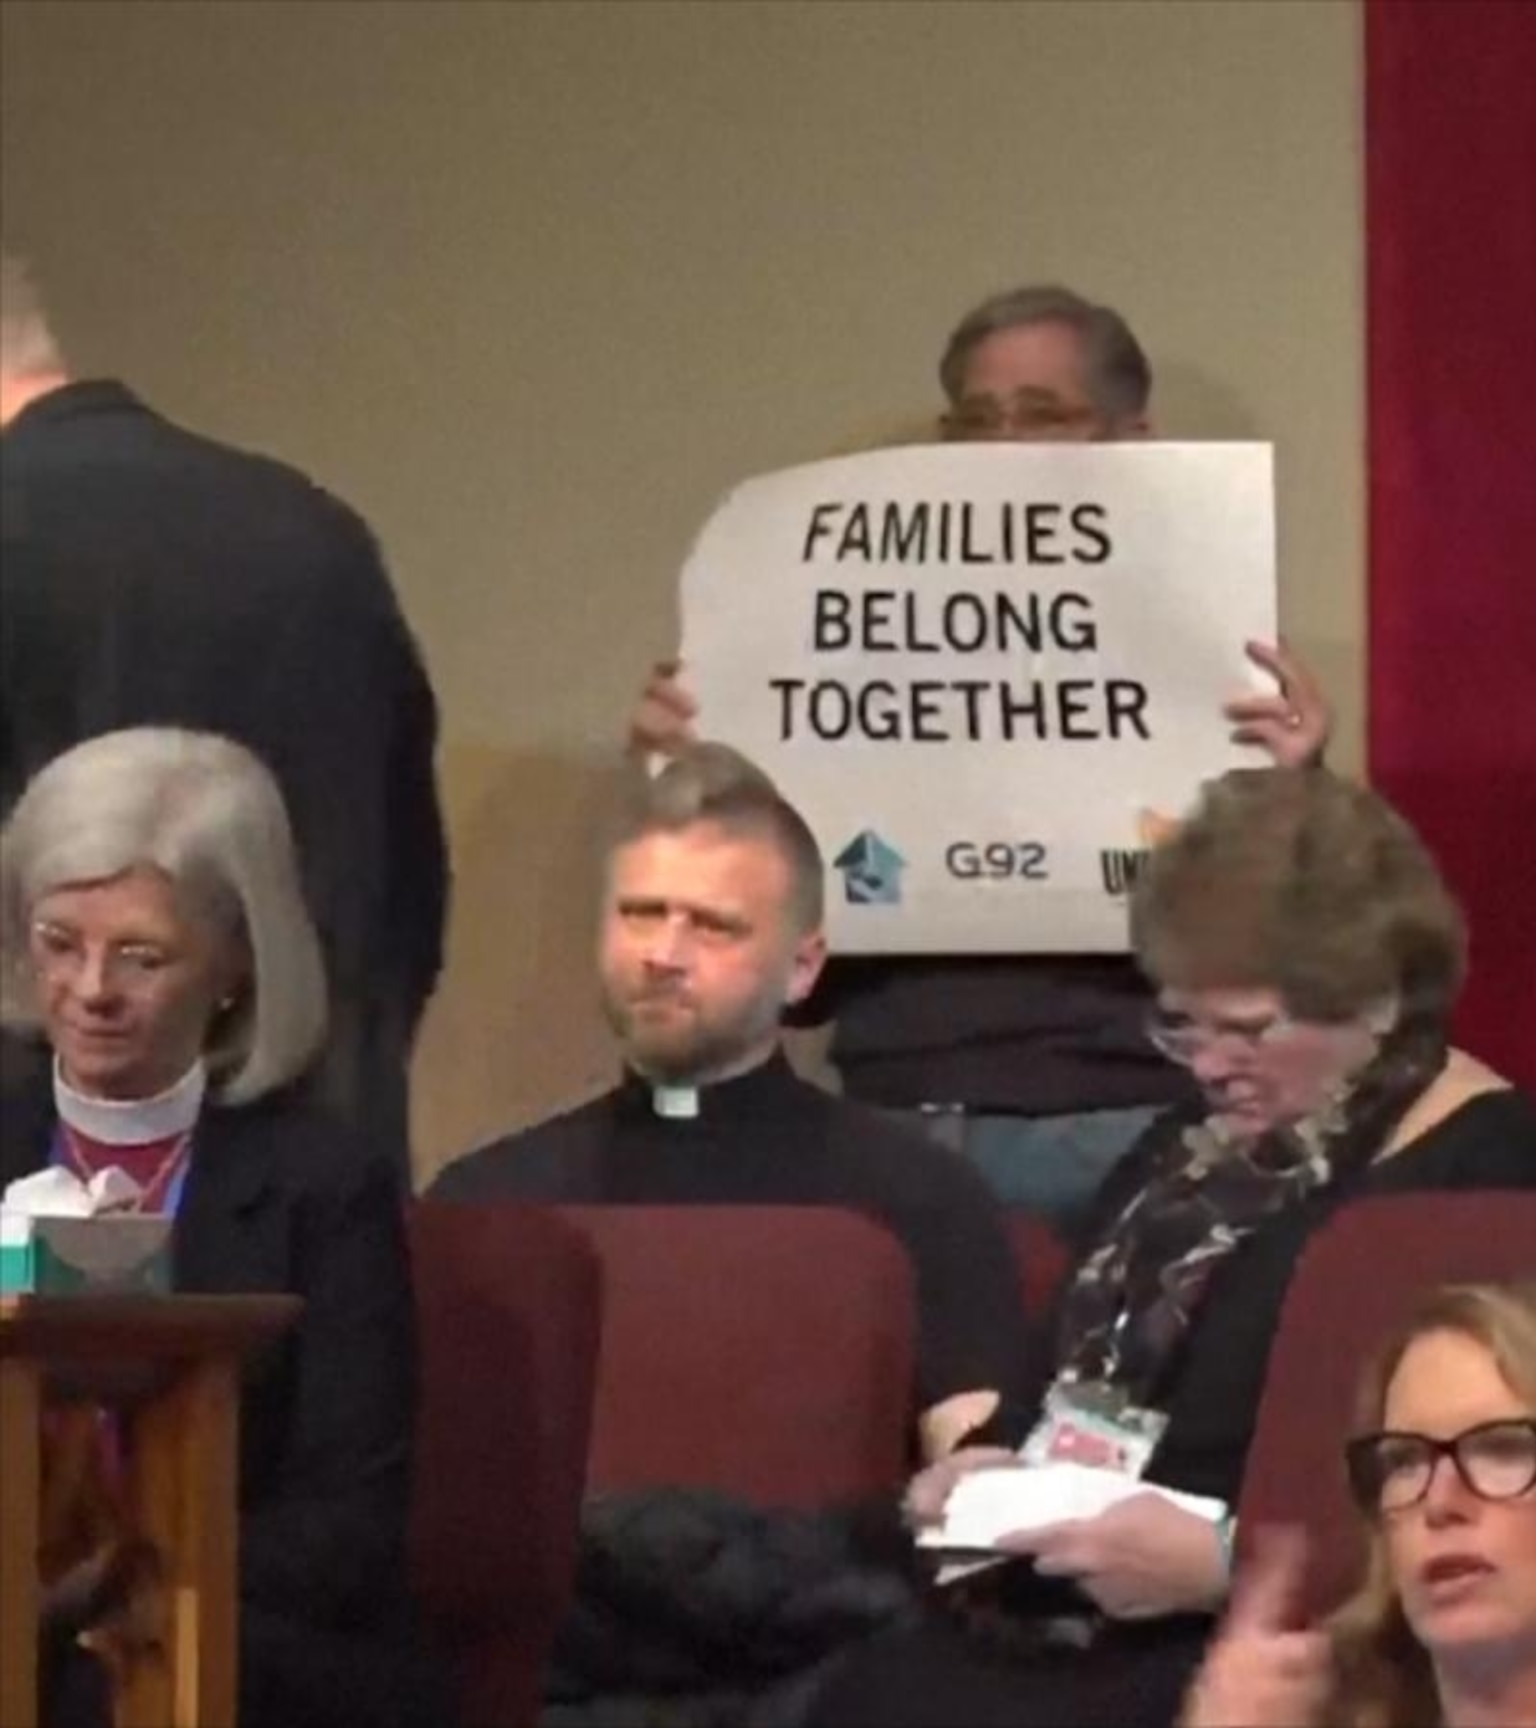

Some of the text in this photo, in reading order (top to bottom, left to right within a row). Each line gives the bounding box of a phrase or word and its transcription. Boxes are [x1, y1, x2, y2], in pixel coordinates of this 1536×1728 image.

[802, 500, 1114, 566] FAMILIES
[813, 588, 1099, 654] BELONG
[768, 678, 1152, 743] TOGETHER
[944, 840, 1050, 881] G92
[1100, 848, 1150, 896] UN
